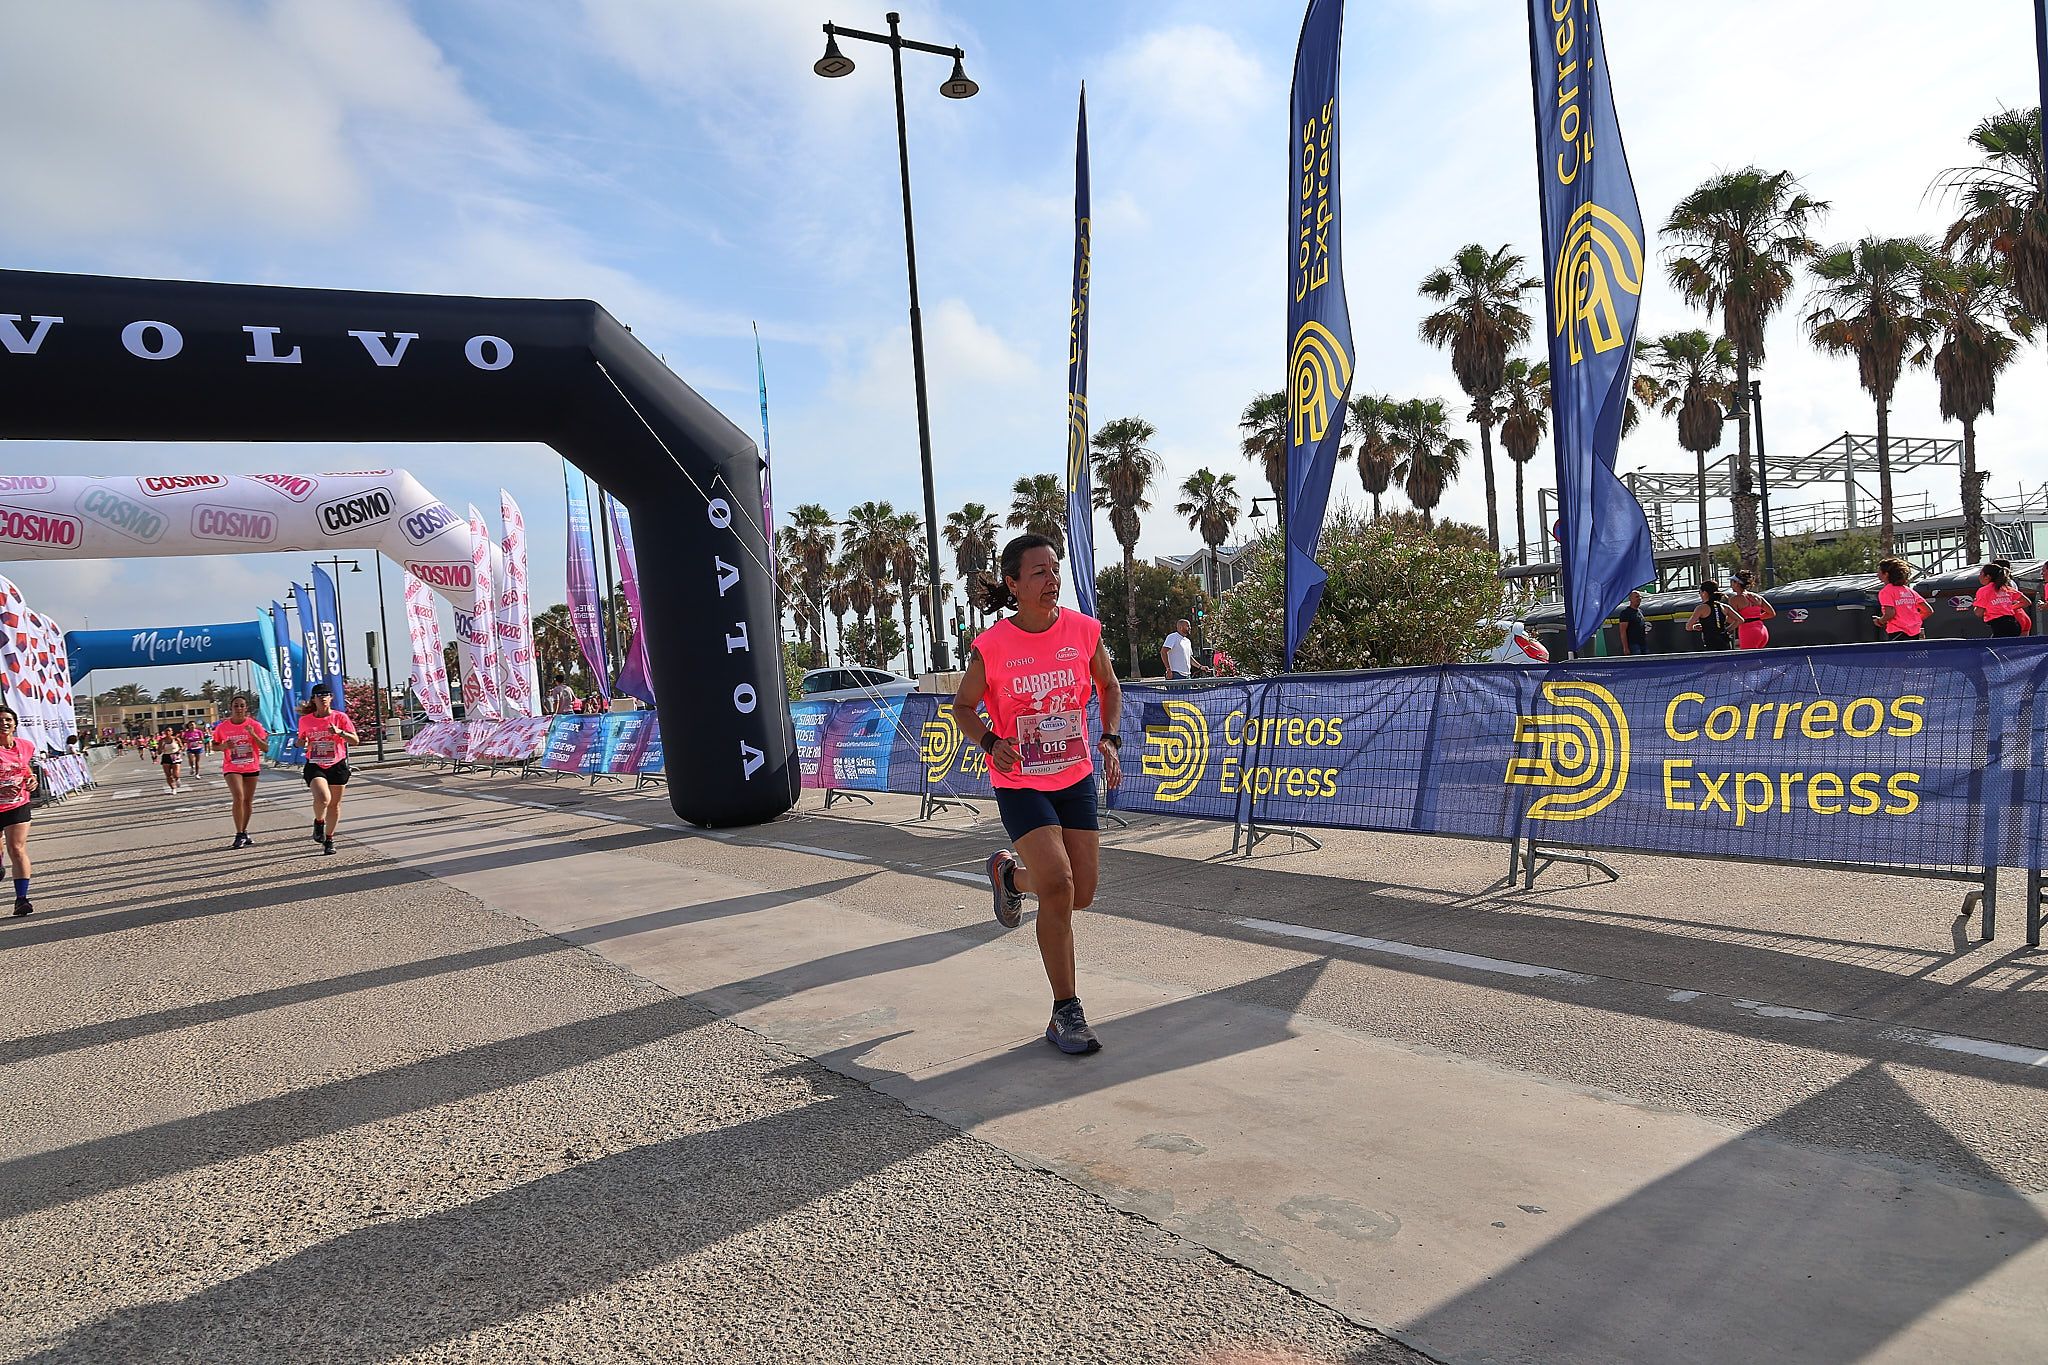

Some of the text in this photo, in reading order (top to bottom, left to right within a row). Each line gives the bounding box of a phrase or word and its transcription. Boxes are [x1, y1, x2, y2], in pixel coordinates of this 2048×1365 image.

[1551, 0, 1580, 184] Correo
[1296, 117, 1315, 302] Correos
[1310, 97, 1335, 290] Express
[0, 314, 514, 371] VOLVO
[0, 477, 48, 491] SMO
[84, 490, 161, 539] COSMO
[199, 508, 272, 540] COSMO
[324, 491, 390, 530] COSMO
[412, 563, 472, 587] COSMO
[455, 611, 473, 638] COS
[708, 498, 765, 781] VOLVO
[131, 630, 212, 661] Marlene
[1006, 656, 1035, 668] OYSHO
[1013, 669, 1076, 694] CARRERA
[1224, 710, 1343, 746] Correos
[1664, 692, 1925, 742] Correos
[1042, 740, 1067, 753] 016
[1220, 758, 1340, 804] Express
[1662, 759, 1921, 827] Express
